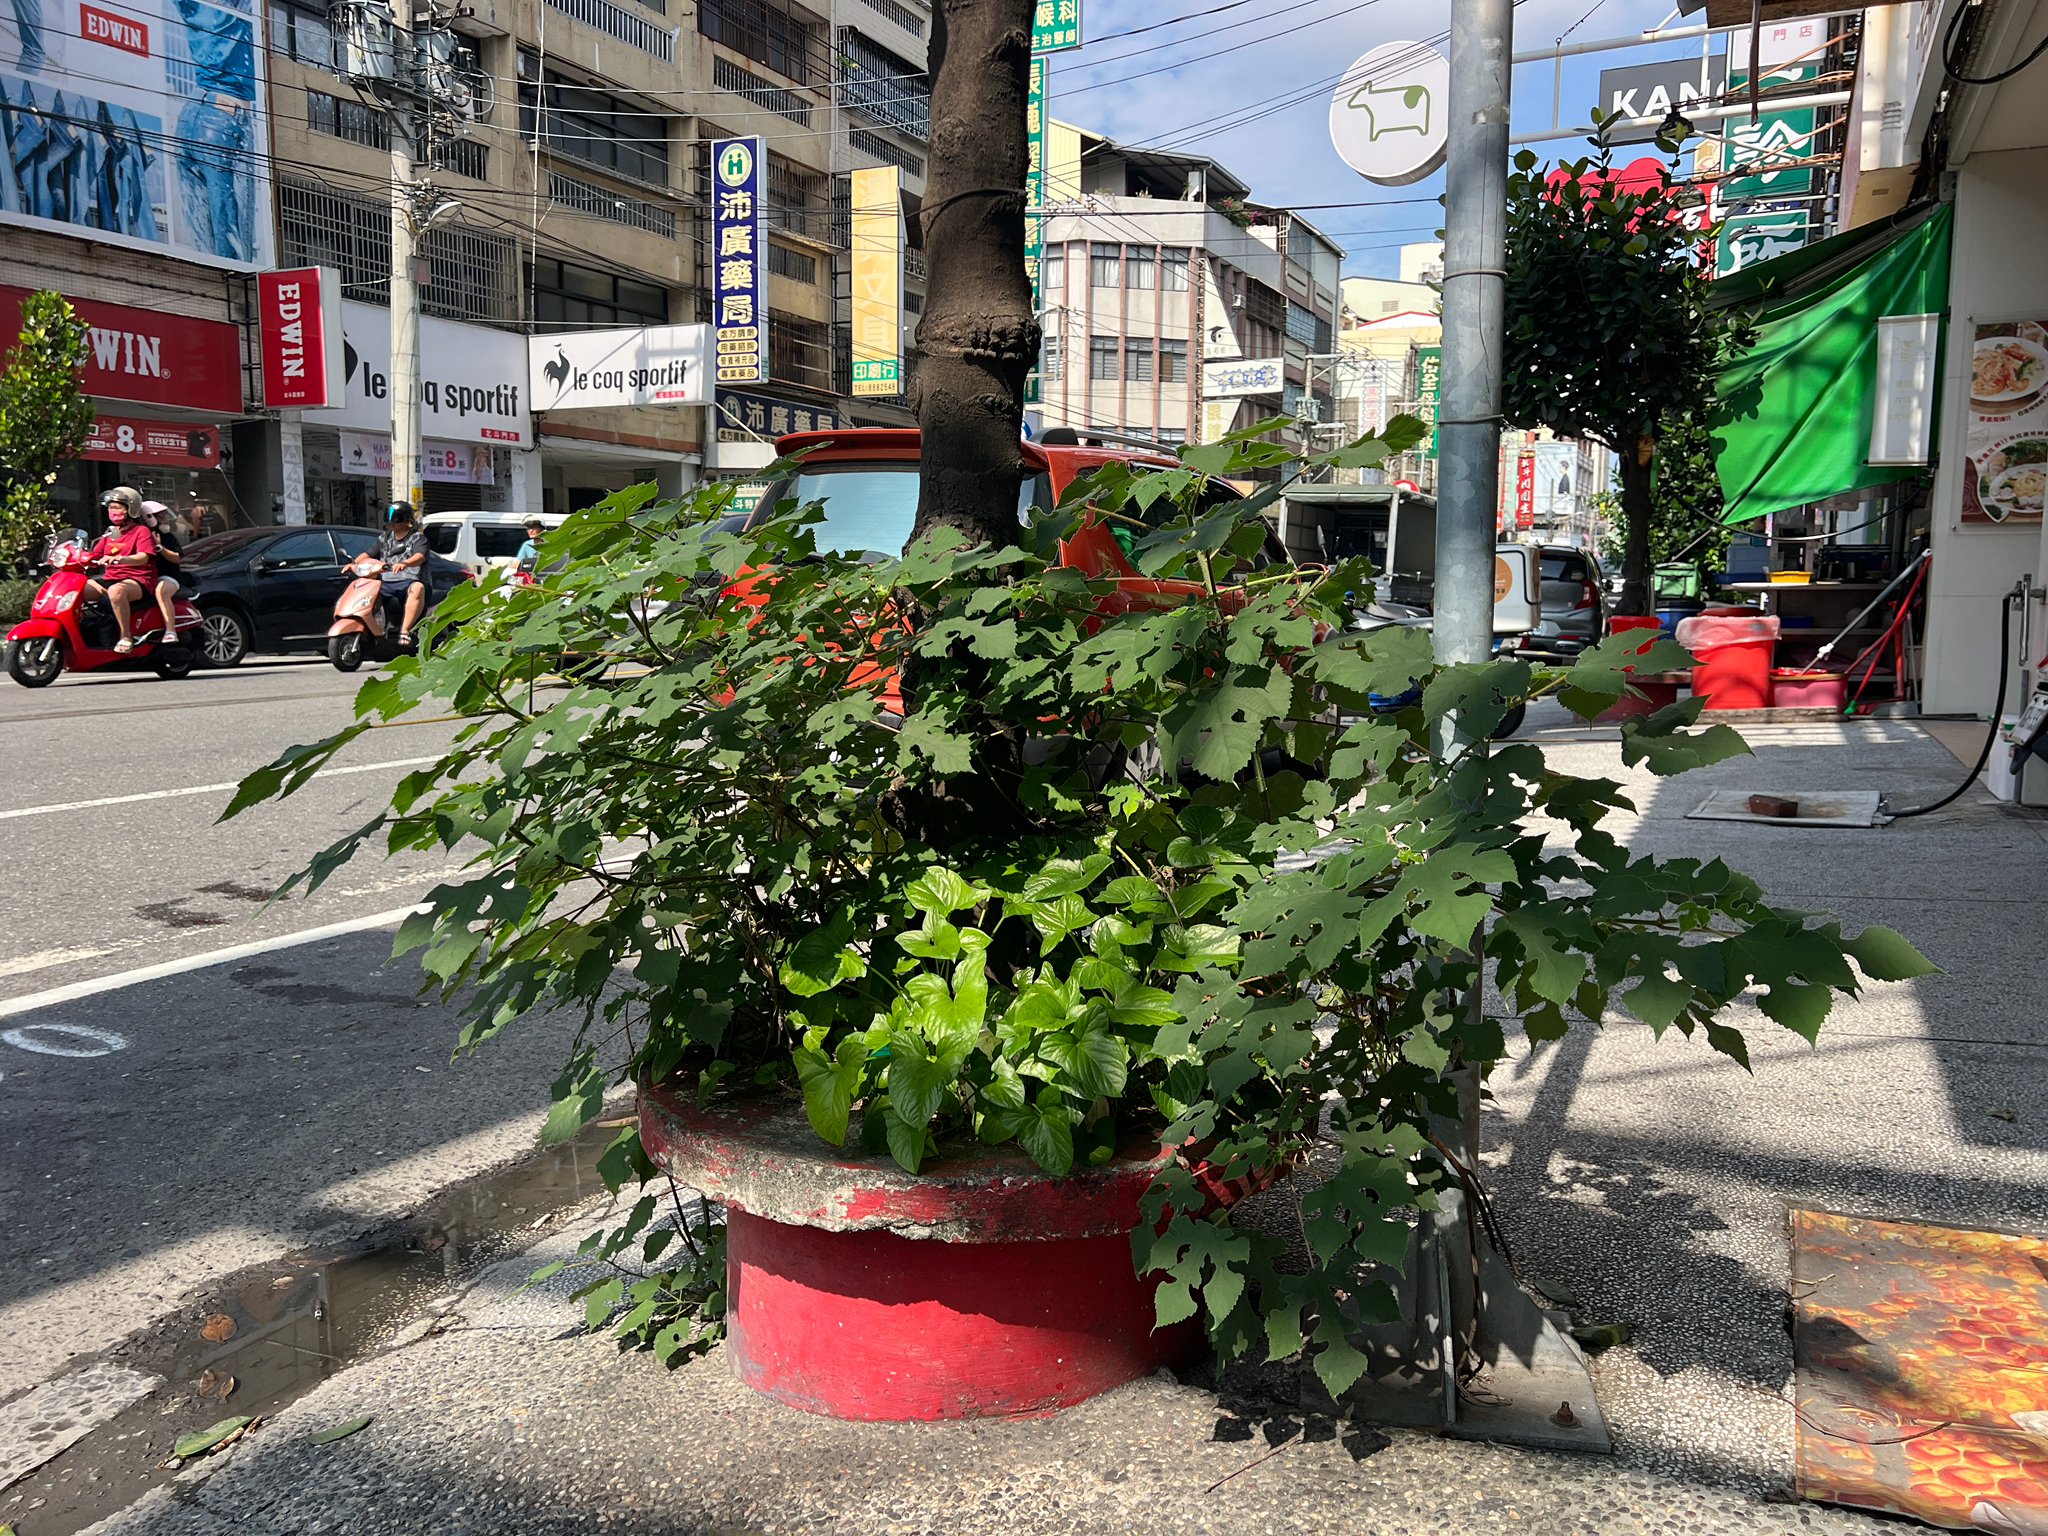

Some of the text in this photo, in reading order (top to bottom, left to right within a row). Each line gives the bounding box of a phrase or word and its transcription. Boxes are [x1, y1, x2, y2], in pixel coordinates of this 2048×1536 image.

[86, 13, 143, 50] EDWIN
[719, 190, 753, 325] 沛廣藥局
[278, 283, 304, 378] EDWIN
[573, 360, 687, 393] le coq sportif
[853, 362, 896, 380] 印刷行
[363, 361, 387, 400] le
[444, 384, 519, 417] sportif
[745, 400, 835, 434] 沛廣藥局
[489, 492, 505, 503] 1882
